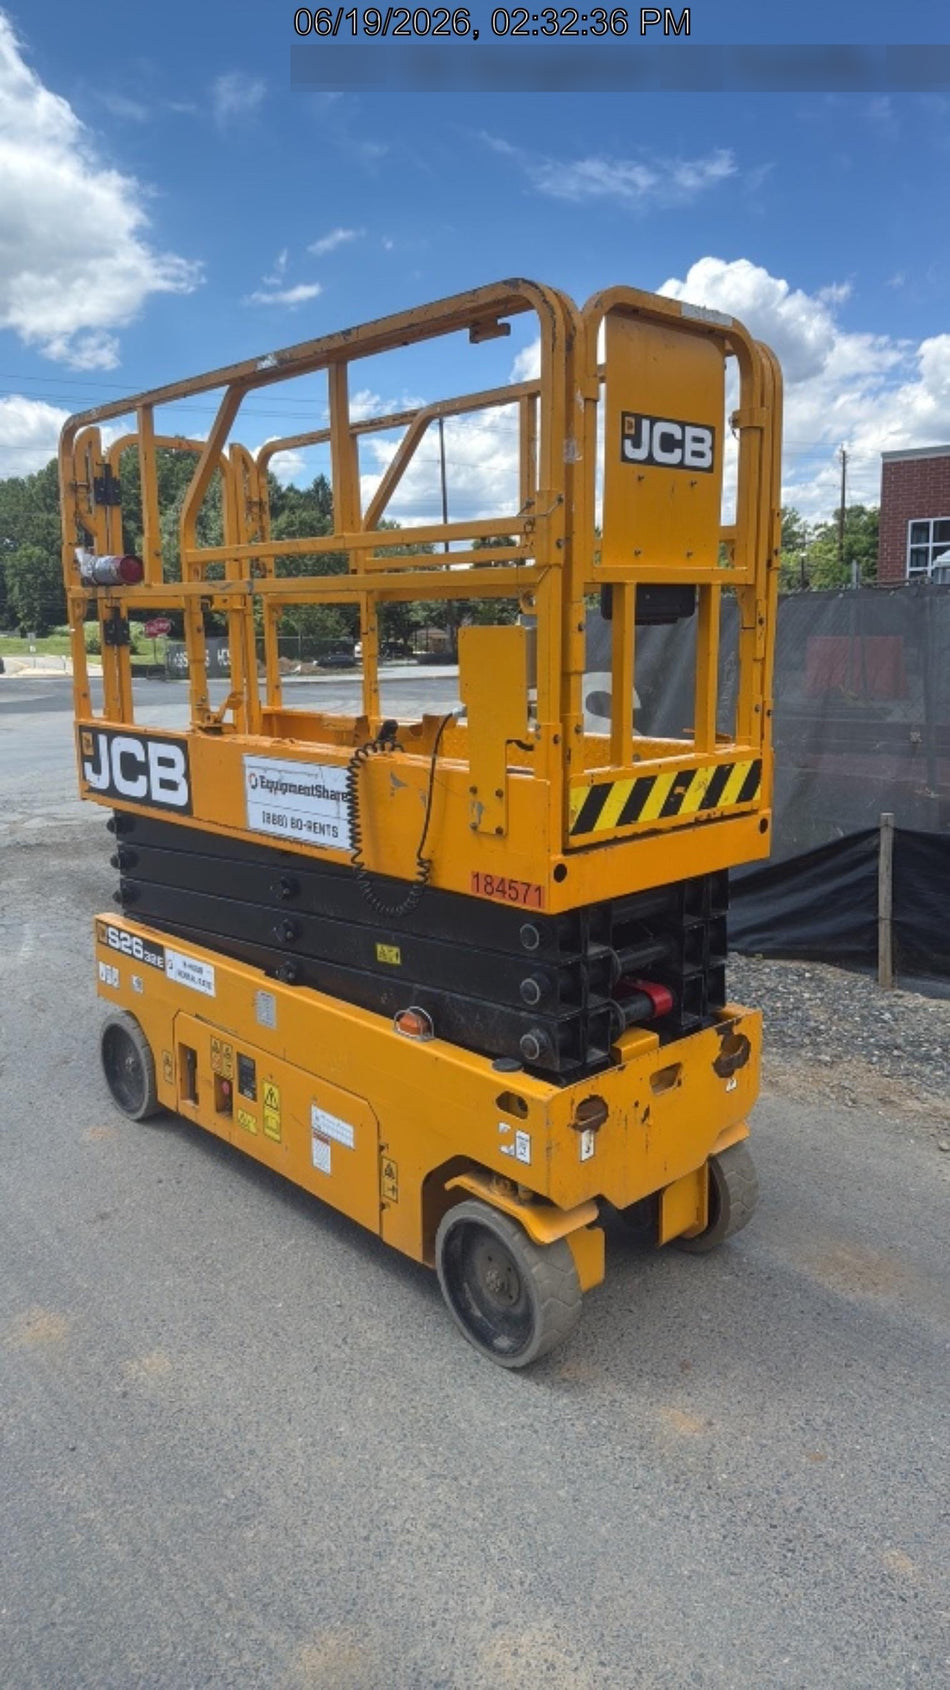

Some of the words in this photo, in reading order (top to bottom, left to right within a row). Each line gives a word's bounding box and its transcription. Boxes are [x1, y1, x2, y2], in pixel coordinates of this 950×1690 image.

[624, 418, 713, 468] JCB
[84, 733, 189, 807] JCB
[259, 775, 349, 802] EquipmentShare
[473, 871, 542, 908] 184571
